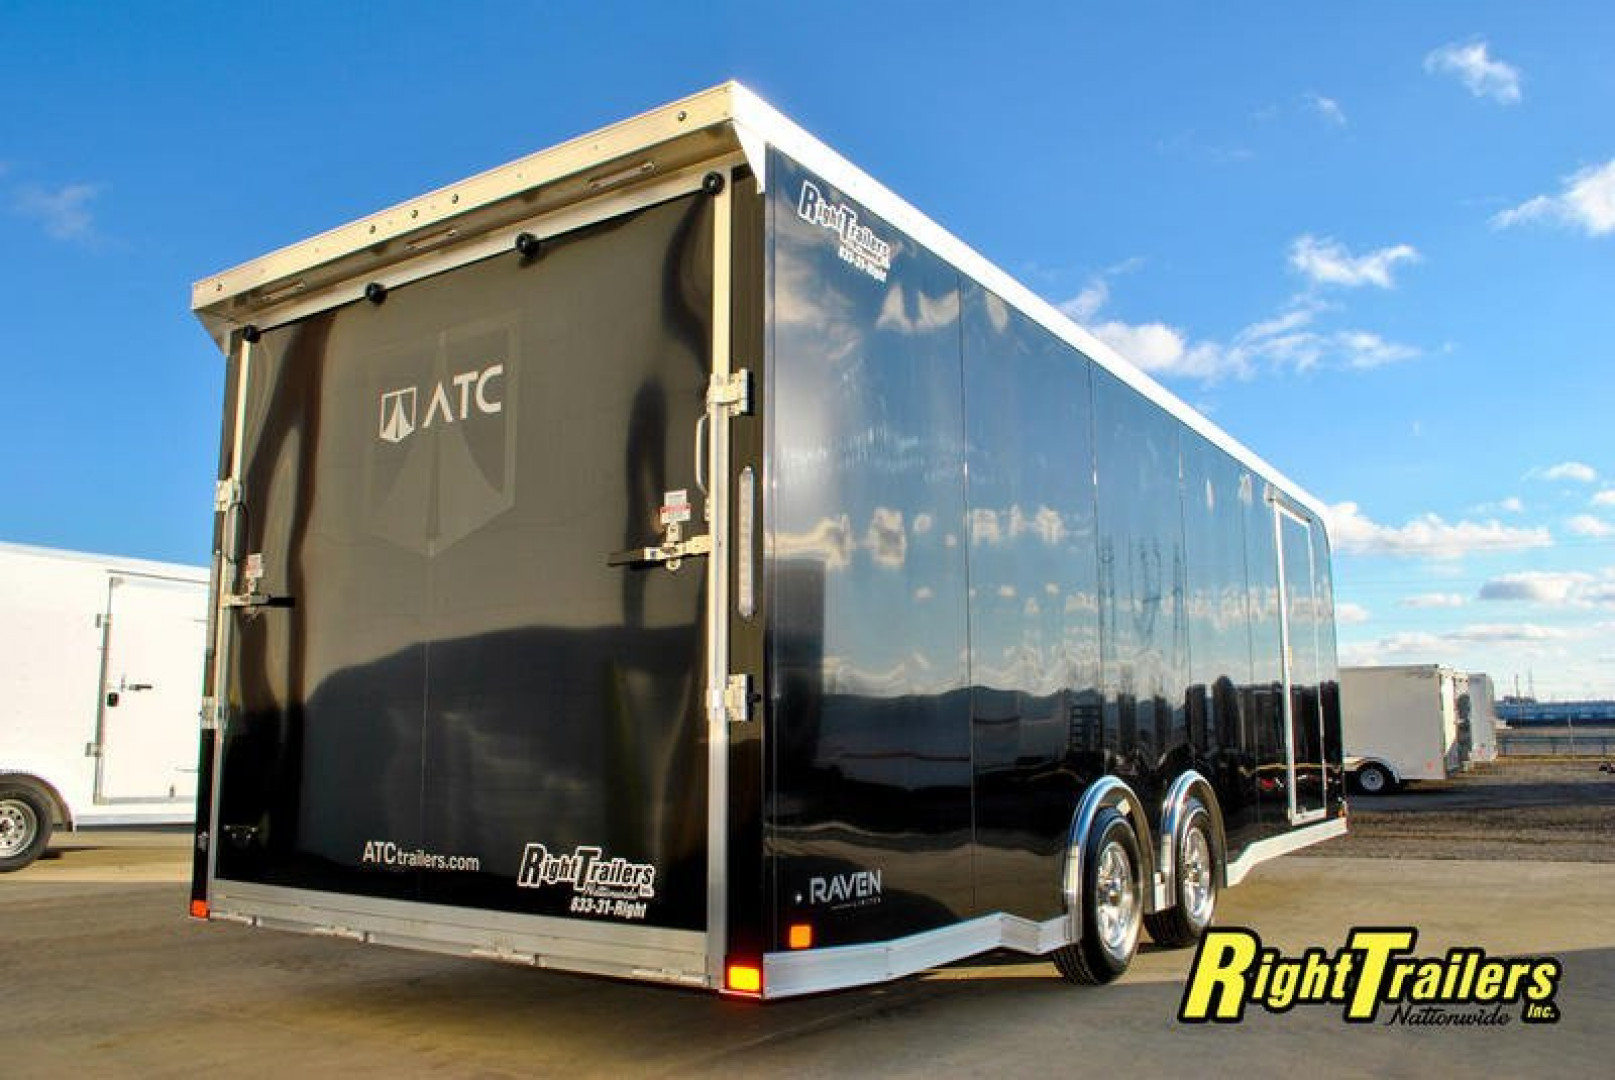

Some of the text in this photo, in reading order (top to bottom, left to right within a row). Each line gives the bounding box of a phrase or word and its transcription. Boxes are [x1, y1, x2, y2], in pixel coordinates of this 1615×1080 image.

[422, 364, 503, 428] ATC
[362, 841, 480, 871] ATCtrailers.com
[809, 868, 882, 904] RAVEN
